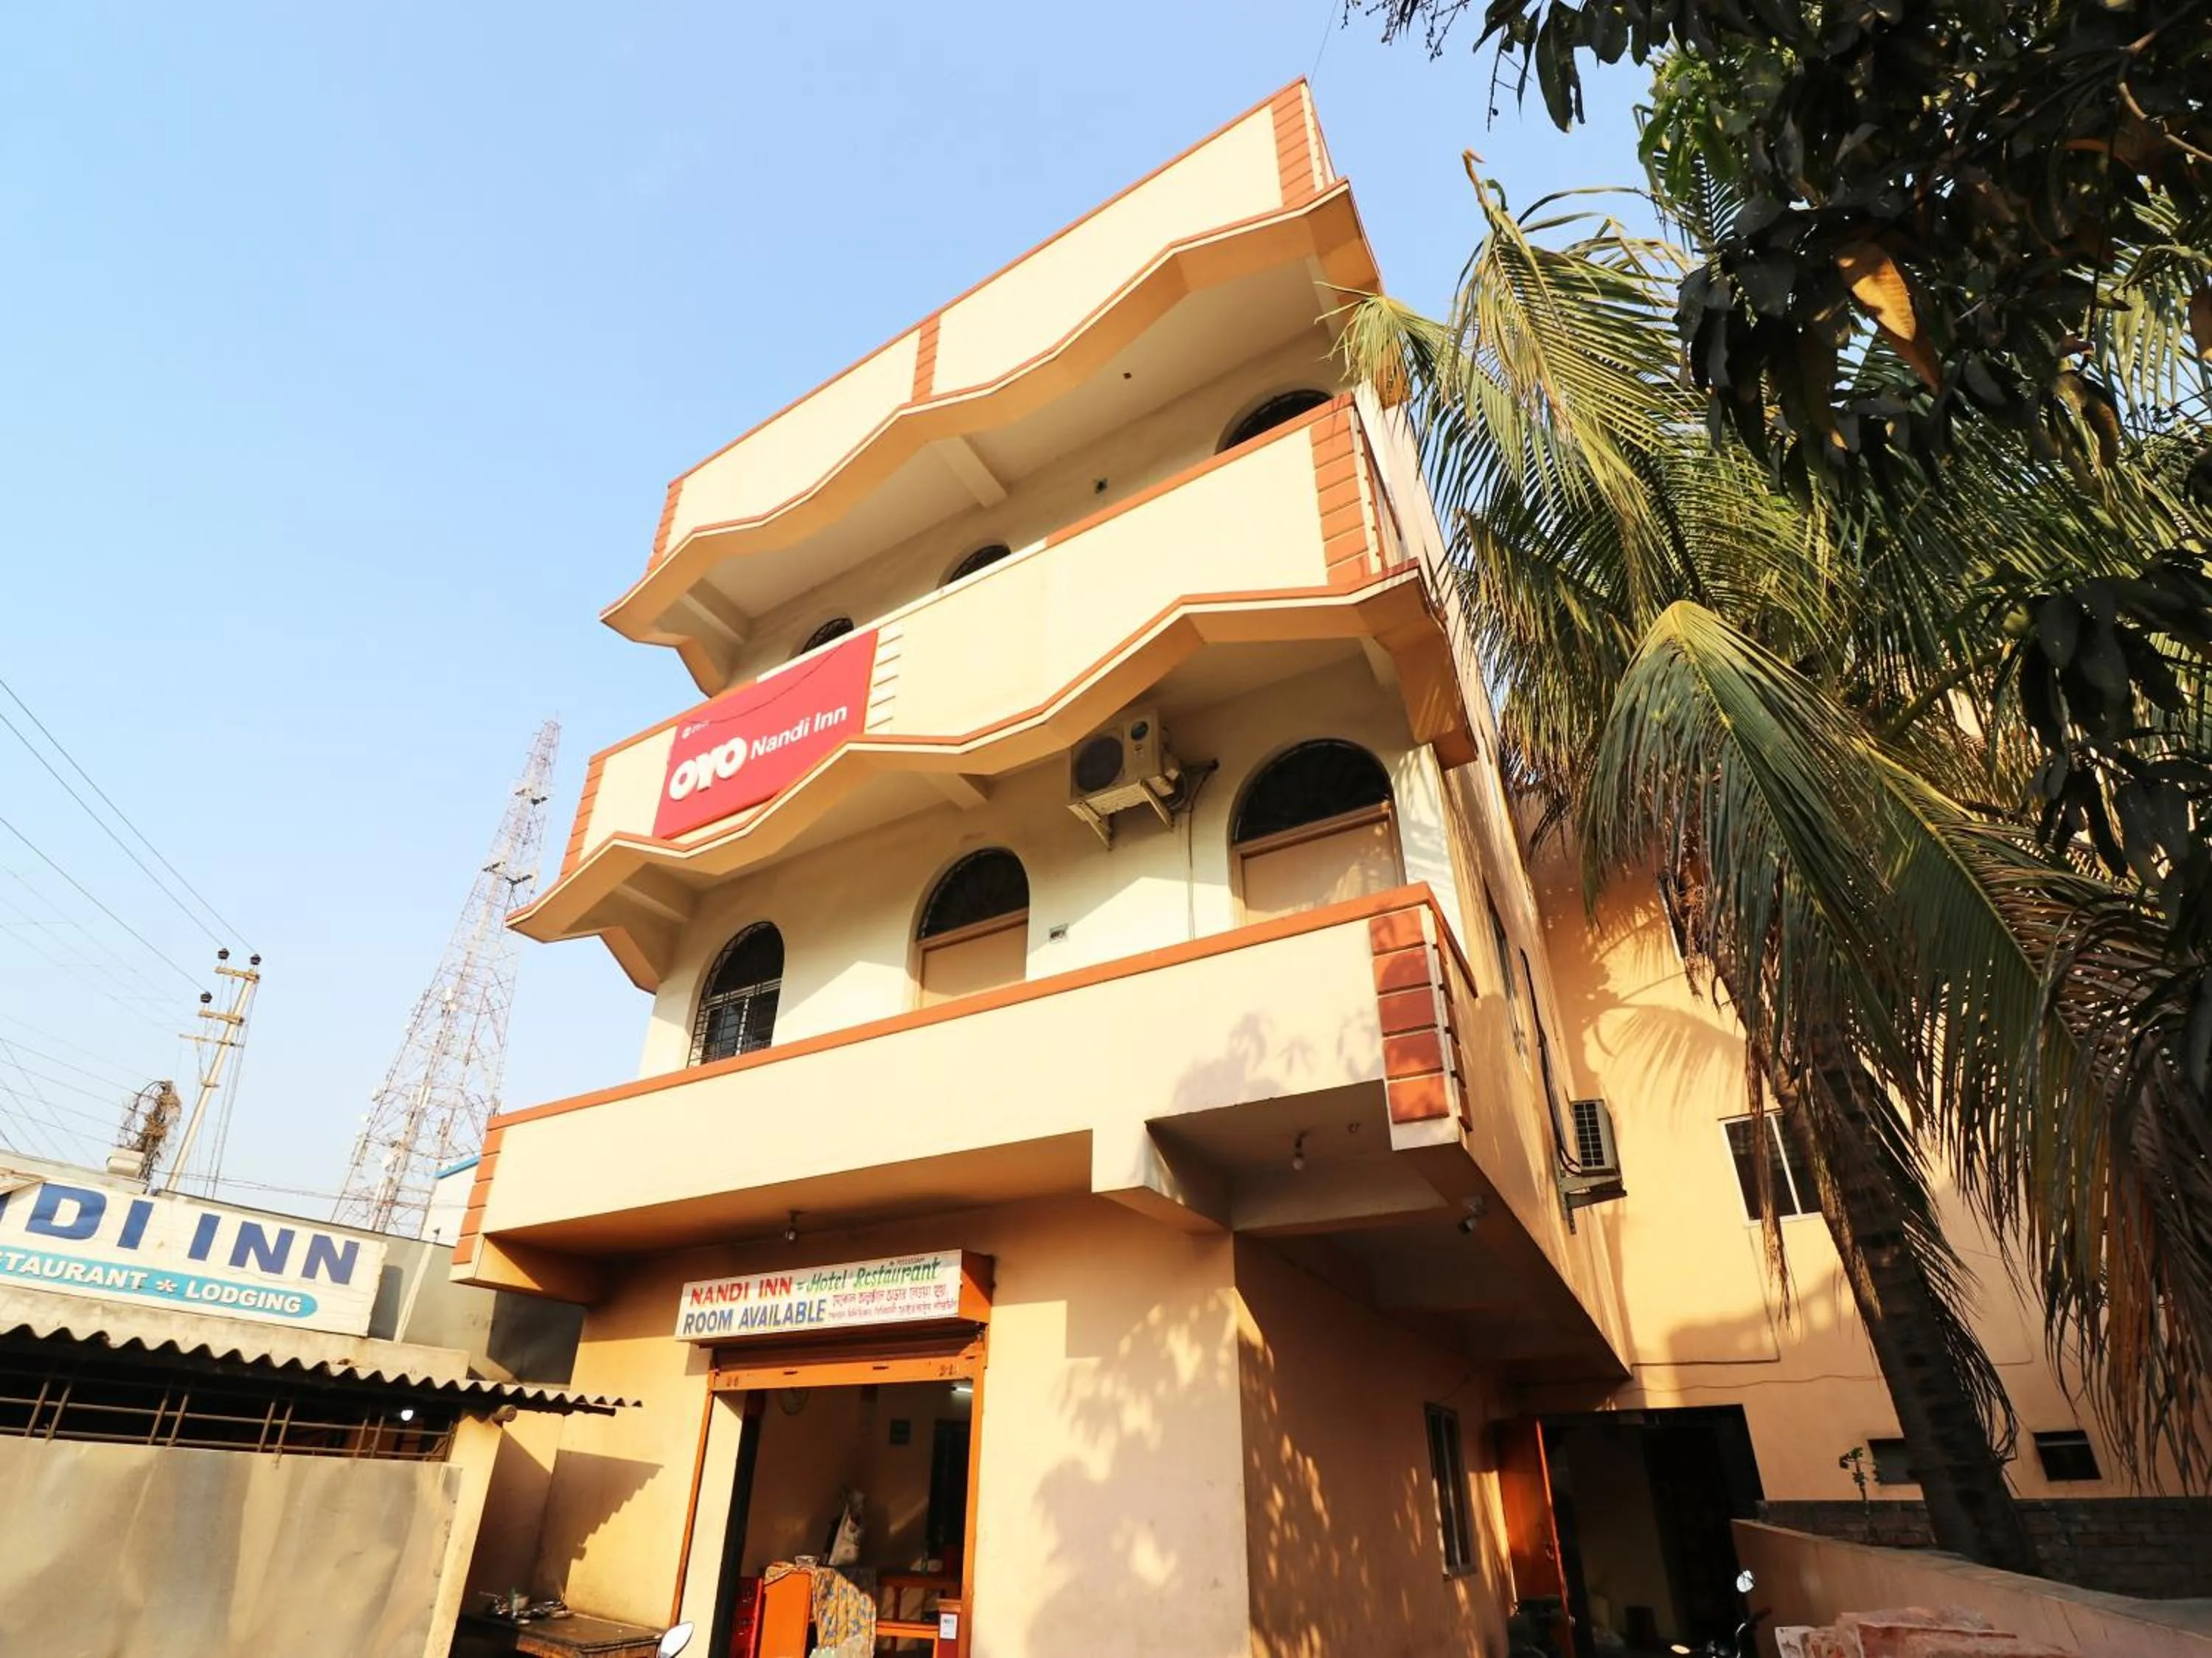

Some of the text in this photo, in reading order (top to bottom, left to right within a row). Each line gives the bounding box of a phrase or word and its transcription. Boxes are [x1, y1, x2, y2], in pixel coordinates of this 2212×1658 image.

[669, 737, 748, 800] OYO
[751, 716, 810, 760] Nandi
[813, 705, 848, 733] Inn
[0, 1182, 361, 1285] DI INN
[185, 1279, 302, 1314] LODGING
[689, 1281, 749, 1306] NANDI
[758, 1276, 793, 1299] INN
[805, 1269, 848, 1294] Hotel
[855, 1257, 942, 1289] Restaurant
[683, 1308, 733, 1335] ROOM
[739, 1298, 827, 1330] AVAILABLE
